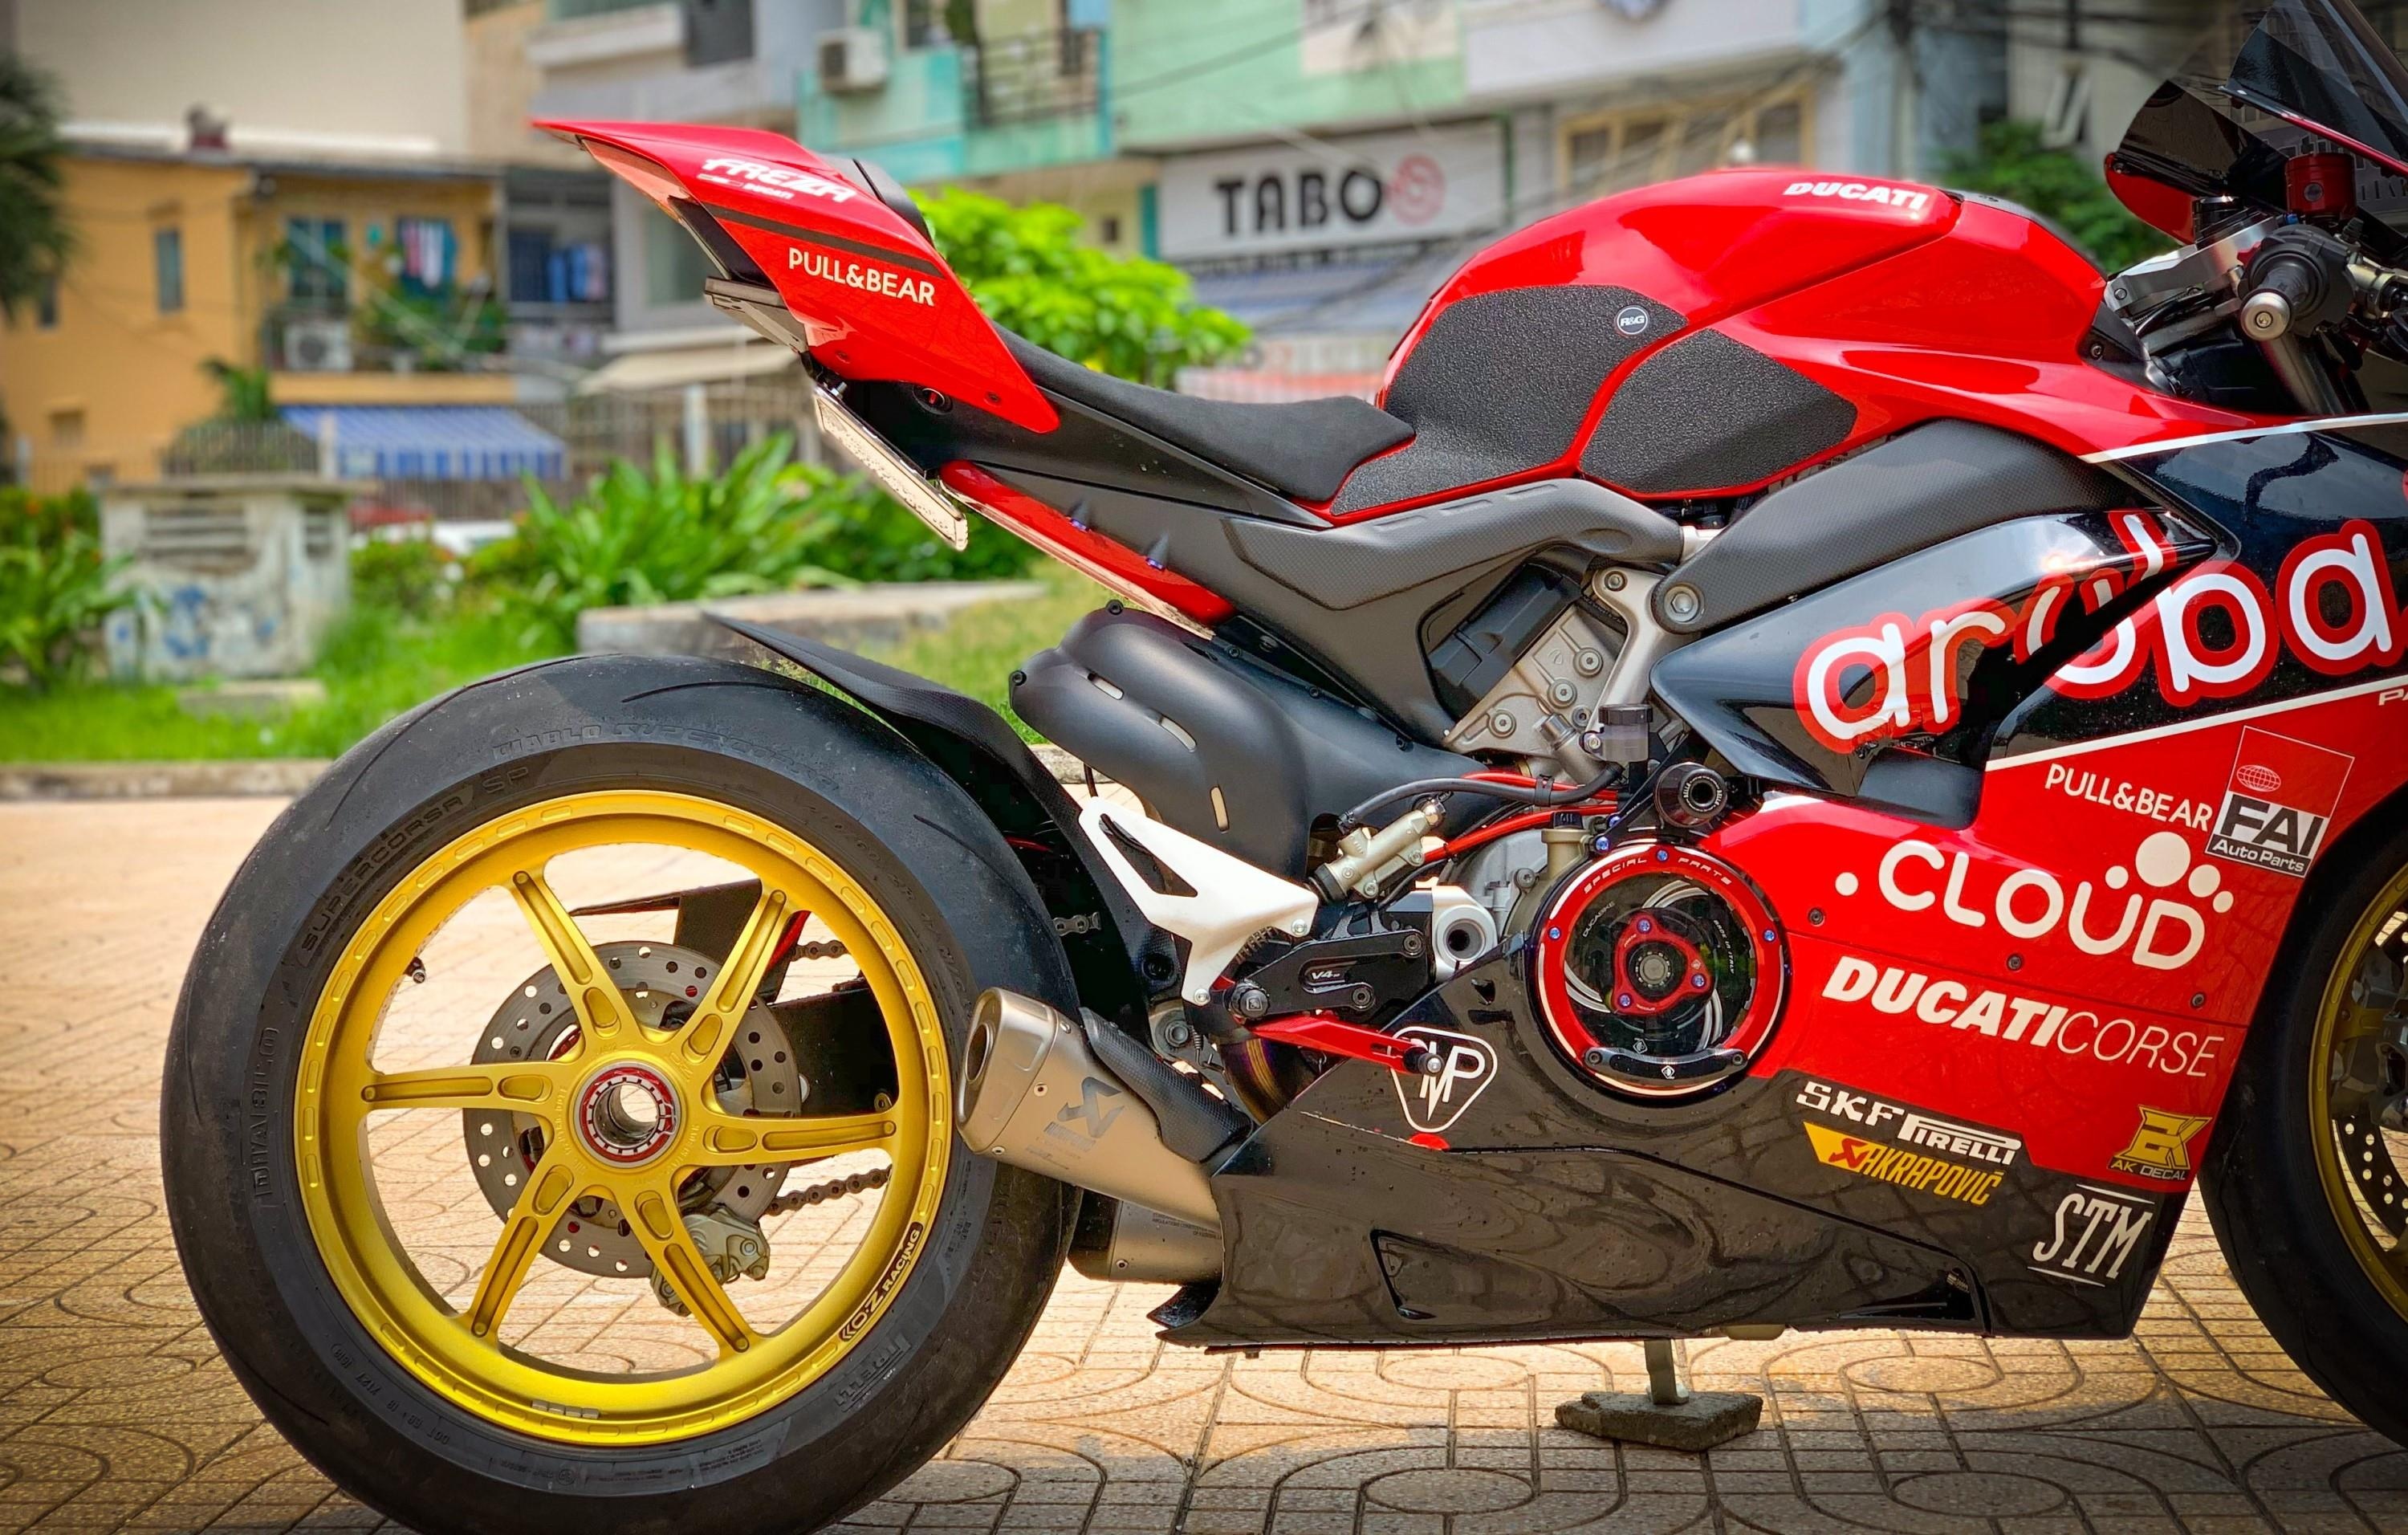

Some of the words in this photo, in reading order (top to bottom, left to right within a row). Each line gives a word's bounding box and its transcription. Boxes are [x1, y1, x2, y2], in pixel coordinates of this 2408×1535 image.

[1782, 181, 1929, 211] DUCATI
[789, 246, 935, 307] PULL&BEAR
[1620, 316, 1645, 327] R&G
[2044, 763, 2214, 832] PULL&BEAR
[2220, 794, 2325, 857] FAI
[302, 795, 464, 952] SUPERCORSA
[482, 766, 530, 795] SP
[1584, 857, 1647, 894] SPECIAL
[1678, 857, 1732, 886] PARTS
[2212, 838, 2259, 863] Auto
[2260, 852, 2304, 873] Parts
[1878, 840, 2206, 970] CLOUD
[1796, 1081, 1905, 1126] SKF
[1897, 1113, 2022, 1165] PIRELLI
[2110, 1160, 2138, 1173] AK
[2139, 1167, 2186, 1181] DECAL
[881, 1228, 921, 1293] RACING
[2032, 1192, 2154, 1279] STM
